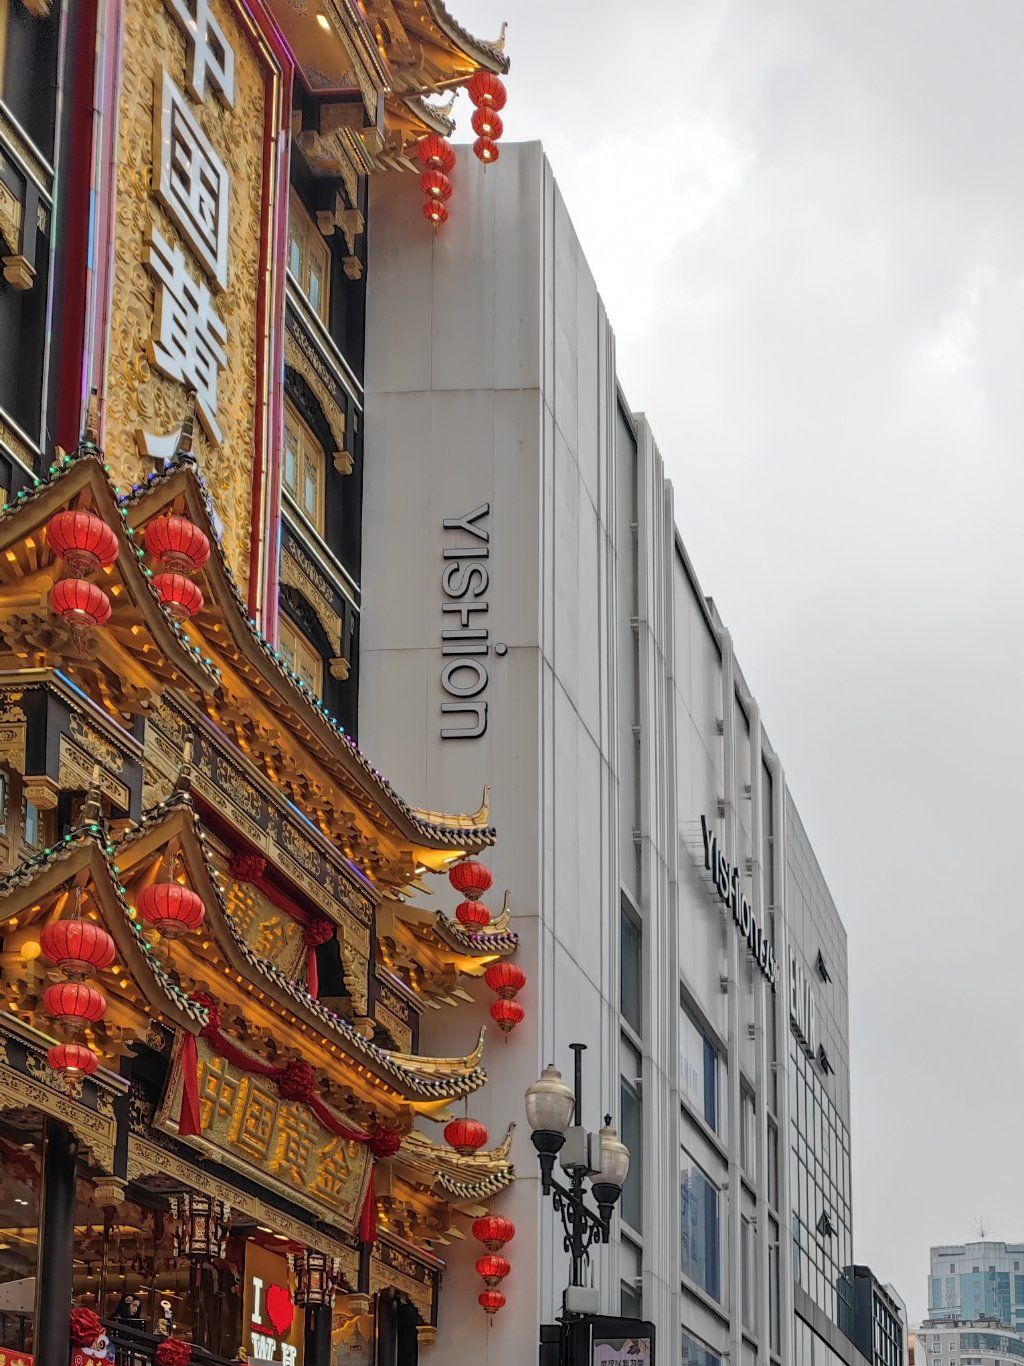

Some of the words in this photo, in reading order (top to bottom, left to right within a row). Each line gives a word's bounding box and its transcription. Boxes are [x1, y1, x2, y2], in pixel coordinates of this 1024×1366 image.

[142, 0, 235, 460] 中国黄
[197, 1056, 352, 1206] 中国黄金
